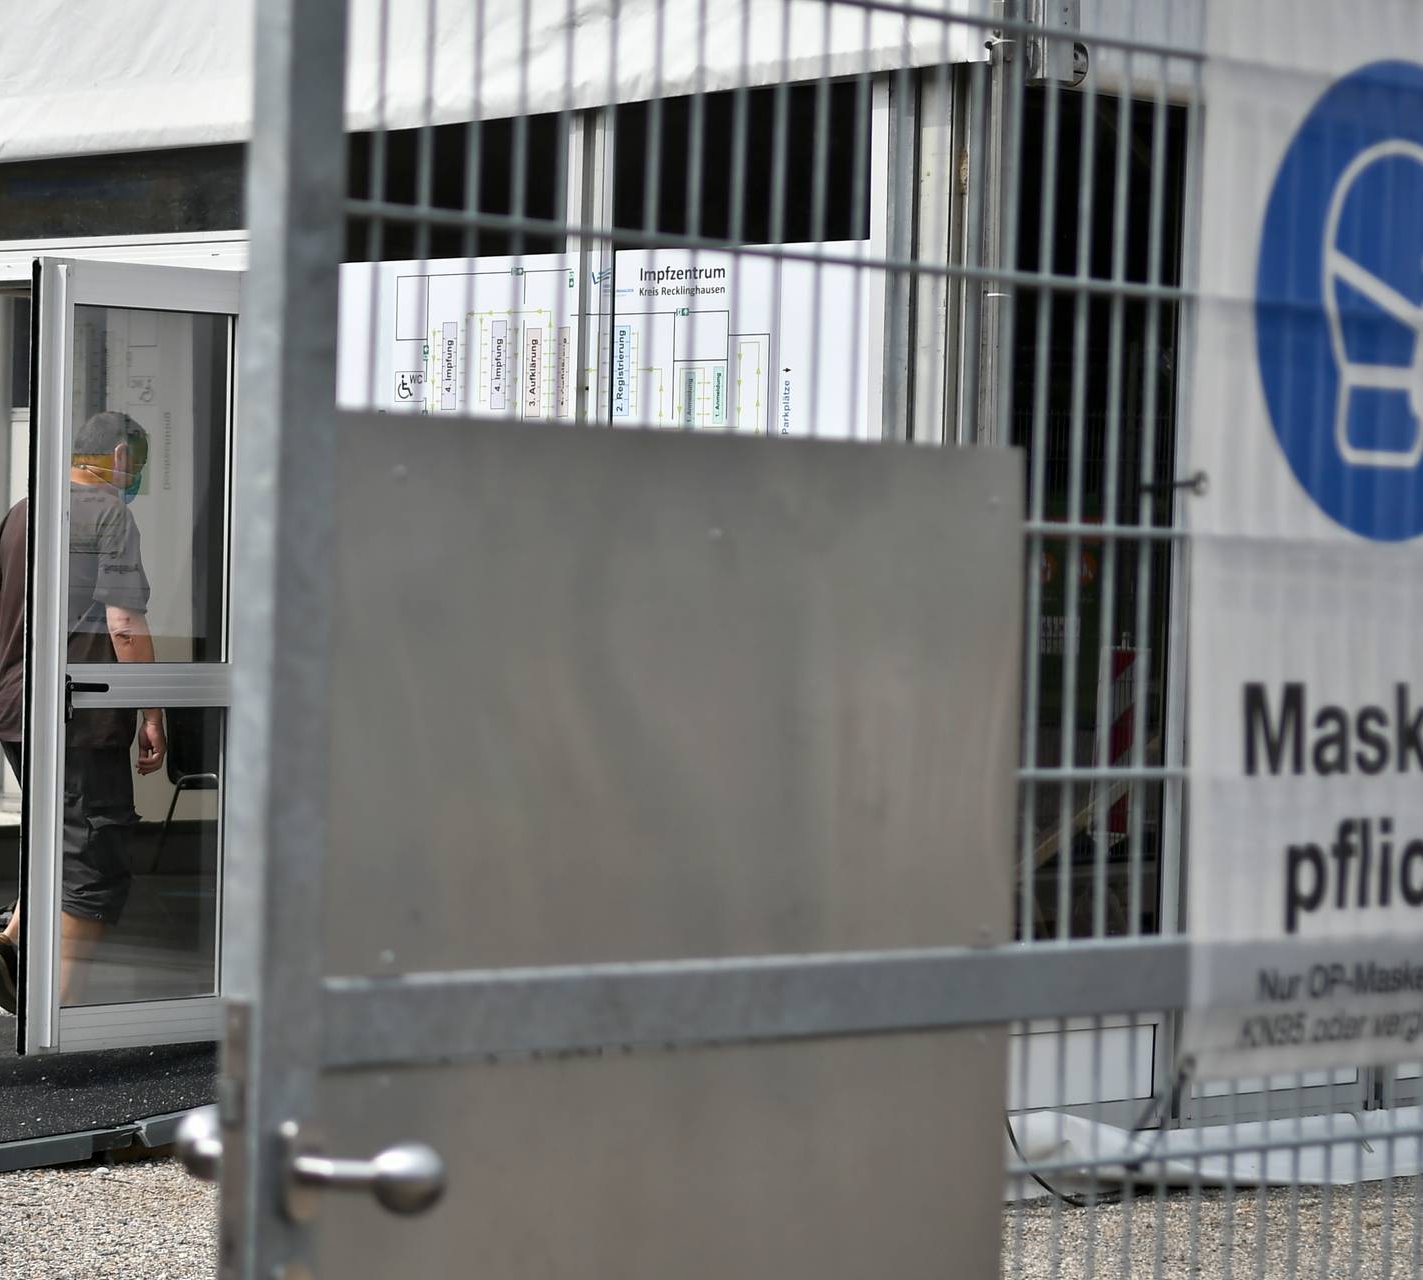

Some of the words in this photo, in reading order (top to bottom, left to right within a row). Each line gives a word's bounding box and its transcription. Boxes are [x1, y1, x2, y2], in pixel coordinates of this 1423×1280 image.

[639, 287, 659, 297] Kreis
[661, 285, 726, 297] Recklinghausen
[640, 266, 726, 284] Impfzentrum
[445, 339, 454, 381] Impfung
[495, 338, 504, 381] Impfung
[528, 338, 539, 393] Aufklärung
[616, 330, 627, 400] Registrierung
[409, 374, 423, 384] WC
[445, 383, 452, 393] 4.
[494, 383, 501, 392] 4.
[616, 403, 623, 412] 2.
[1243, 681, 1423, 776] Mask
[1257, 968, 1300, 1001] Nur
[1312, 1010, 1368, 1042] oder
